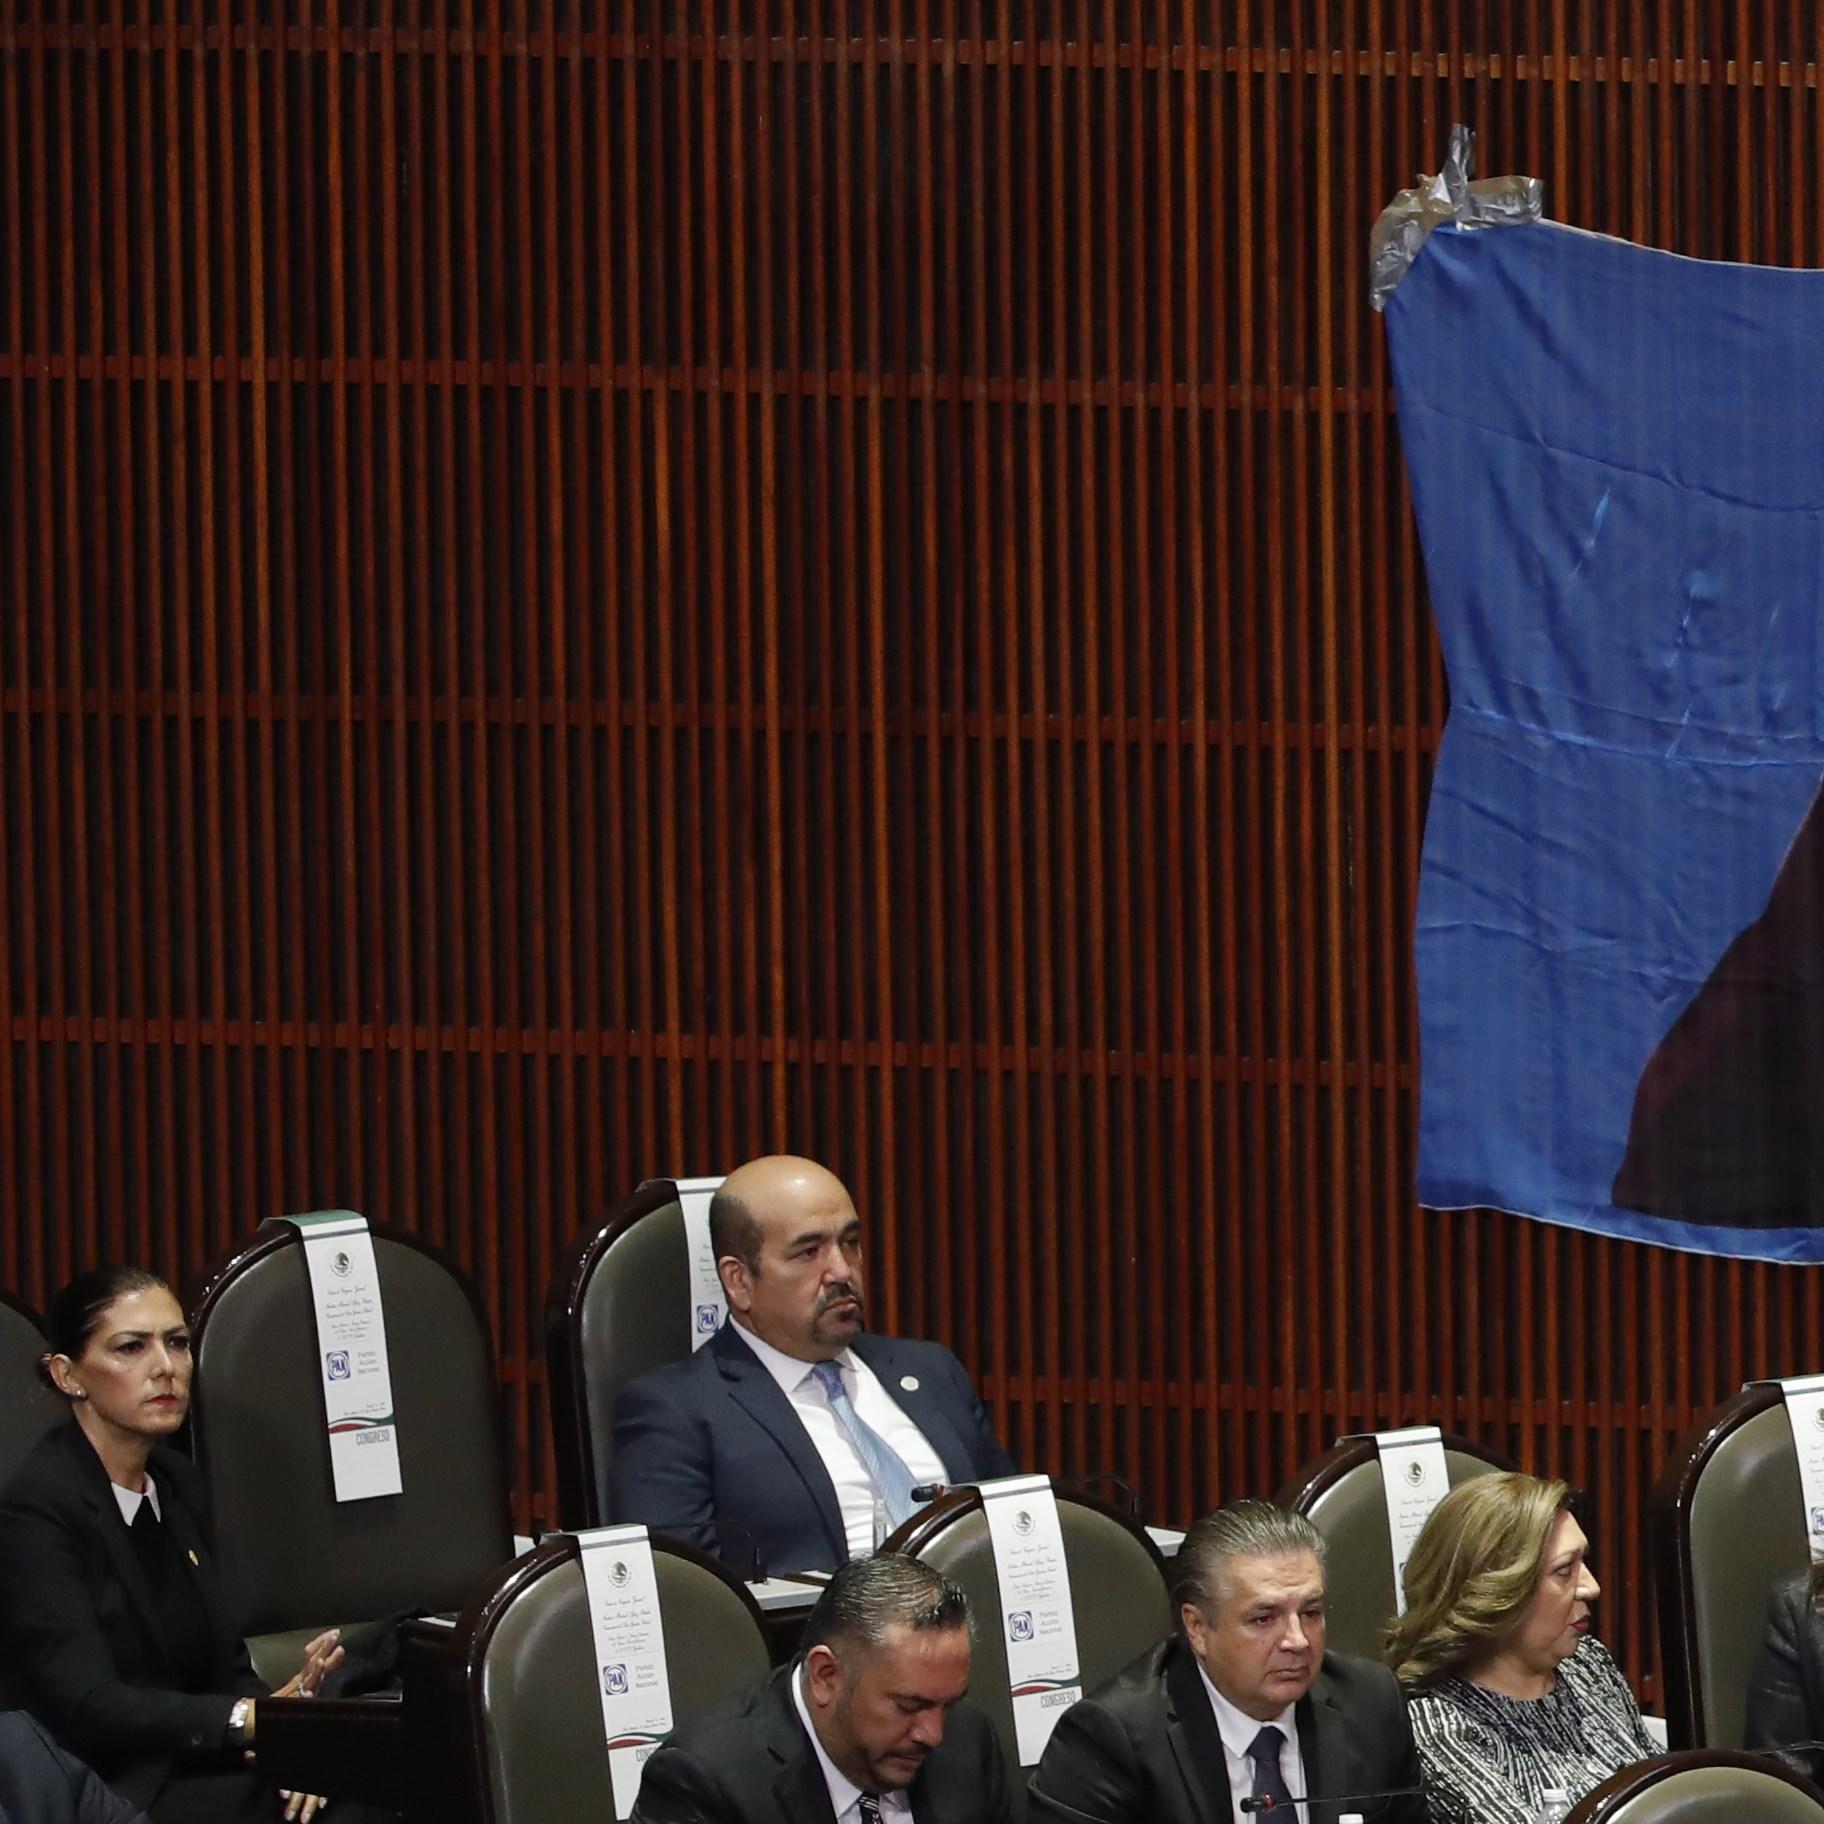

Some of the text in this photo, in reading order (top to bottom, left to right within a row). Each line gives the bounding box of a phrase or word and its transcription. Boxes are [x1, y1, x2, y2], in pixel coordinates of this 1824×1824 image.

[332, 1360, 346, 1372] PAN
[355, 1429, 390, 1445] CONGRESO
[1014, 1620, 1028, 1633] PAN
[610, 1672, 624, 1686] PAN
